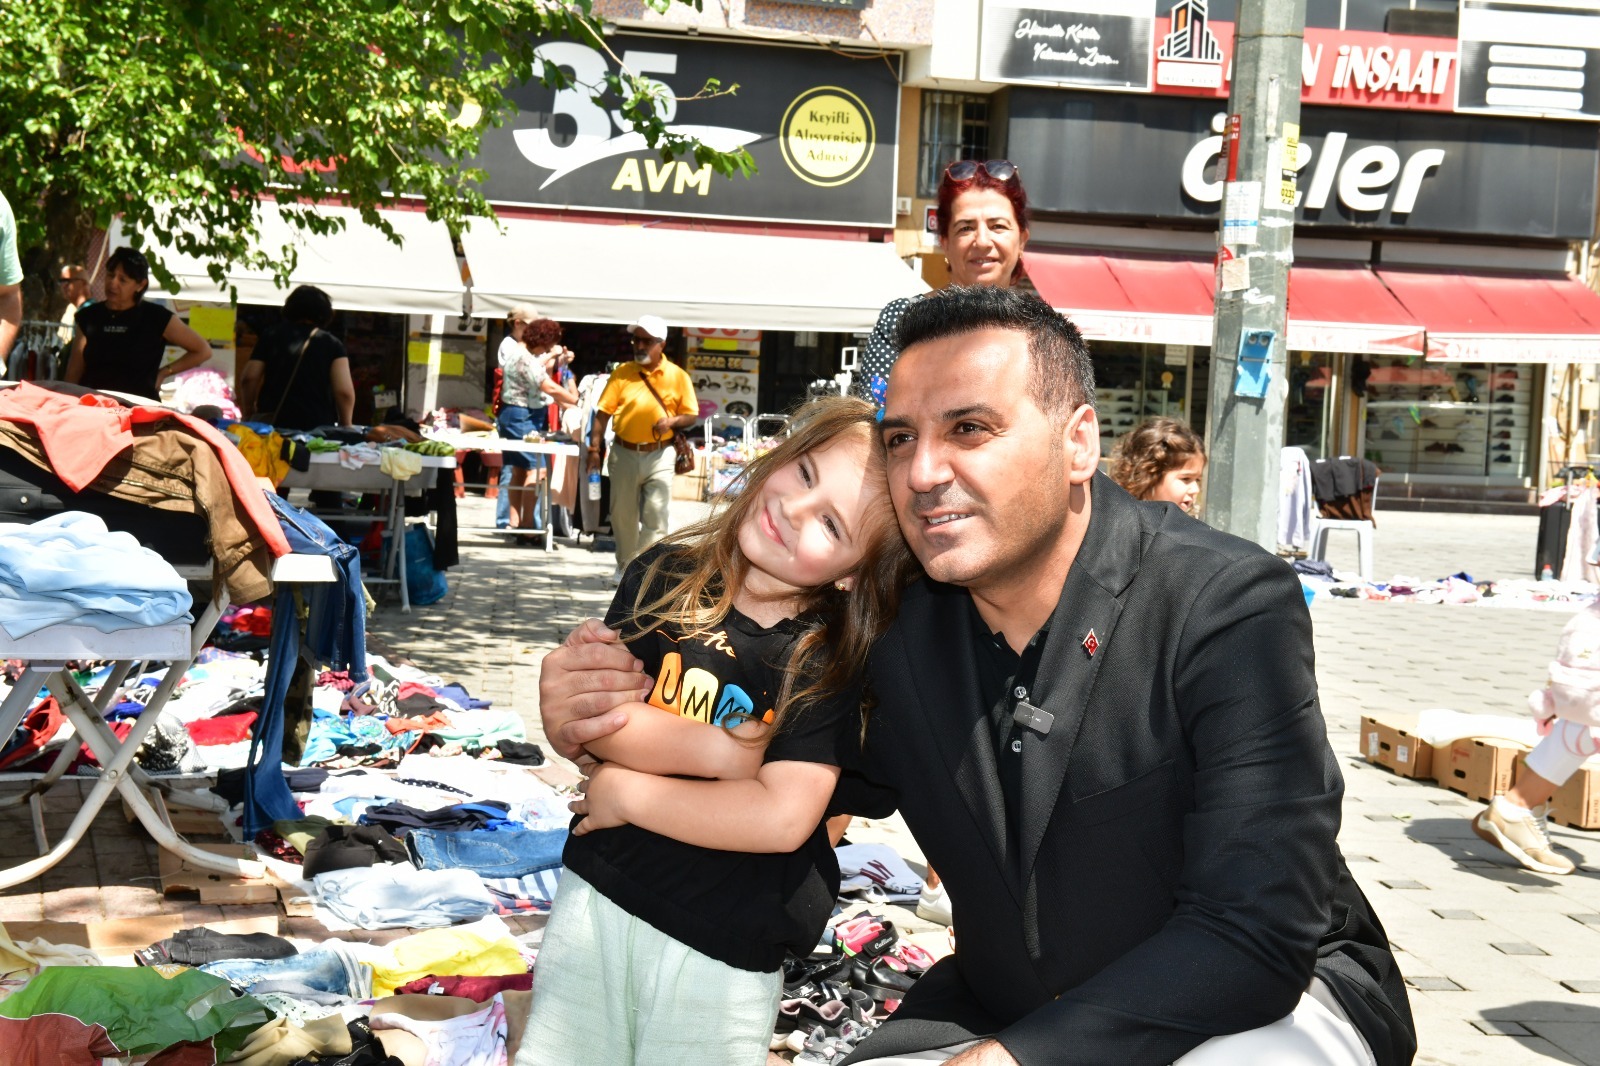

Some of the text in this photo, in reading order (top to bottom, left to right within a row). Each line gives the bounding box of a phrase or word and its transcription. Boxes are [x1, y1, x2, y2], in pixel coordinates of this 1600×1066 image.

[513, 41, 678, 171] 35
[611, 158, 713, 196] AVM
[1182, 112, 1445, 213] öler
